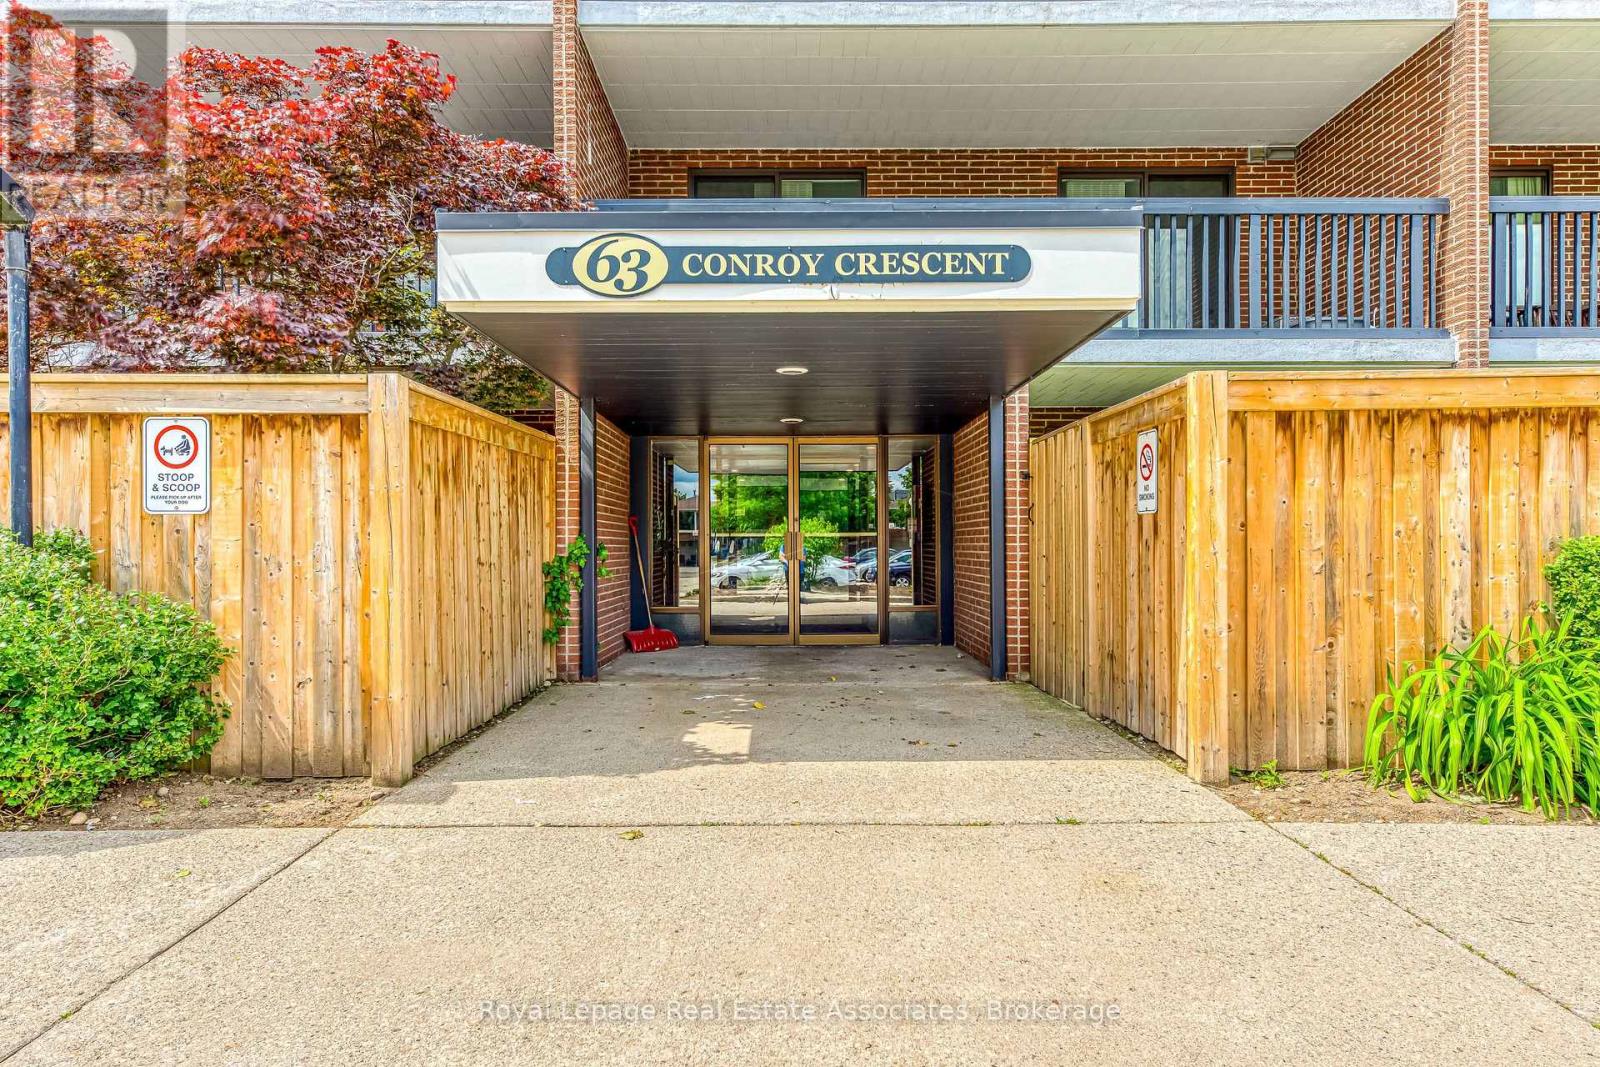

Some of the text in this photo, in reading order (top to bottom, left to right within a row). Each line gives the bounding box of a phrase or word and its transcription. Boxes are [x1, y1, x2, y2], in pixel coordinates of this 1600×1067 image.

[586, 238, 1009, 293] 63 CONROY CRESCENT
[157, 473, 194, 481] STOOP
[152, 483, 200, 492] & SCOOP
[1143, 484, 1149, 492] NO
